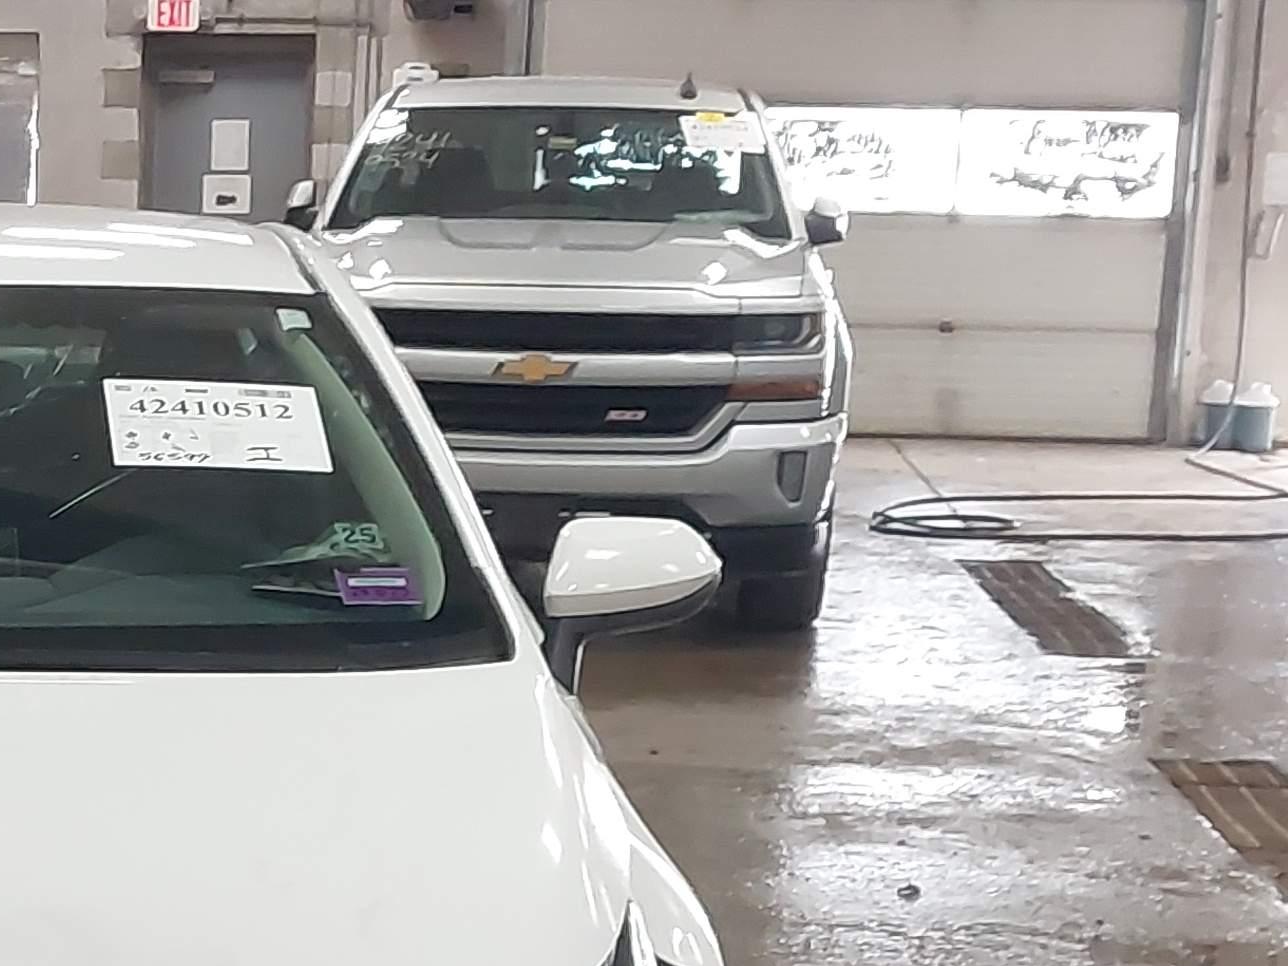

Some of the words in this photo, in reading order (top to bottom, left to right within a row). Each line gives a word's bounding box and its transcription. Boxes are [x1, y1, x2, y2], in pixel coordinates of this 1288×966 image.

[157, 0, 193, 27] EXIT
[129, 399, 293, 420] 42410512
[341, 527, 377, 544] 25
